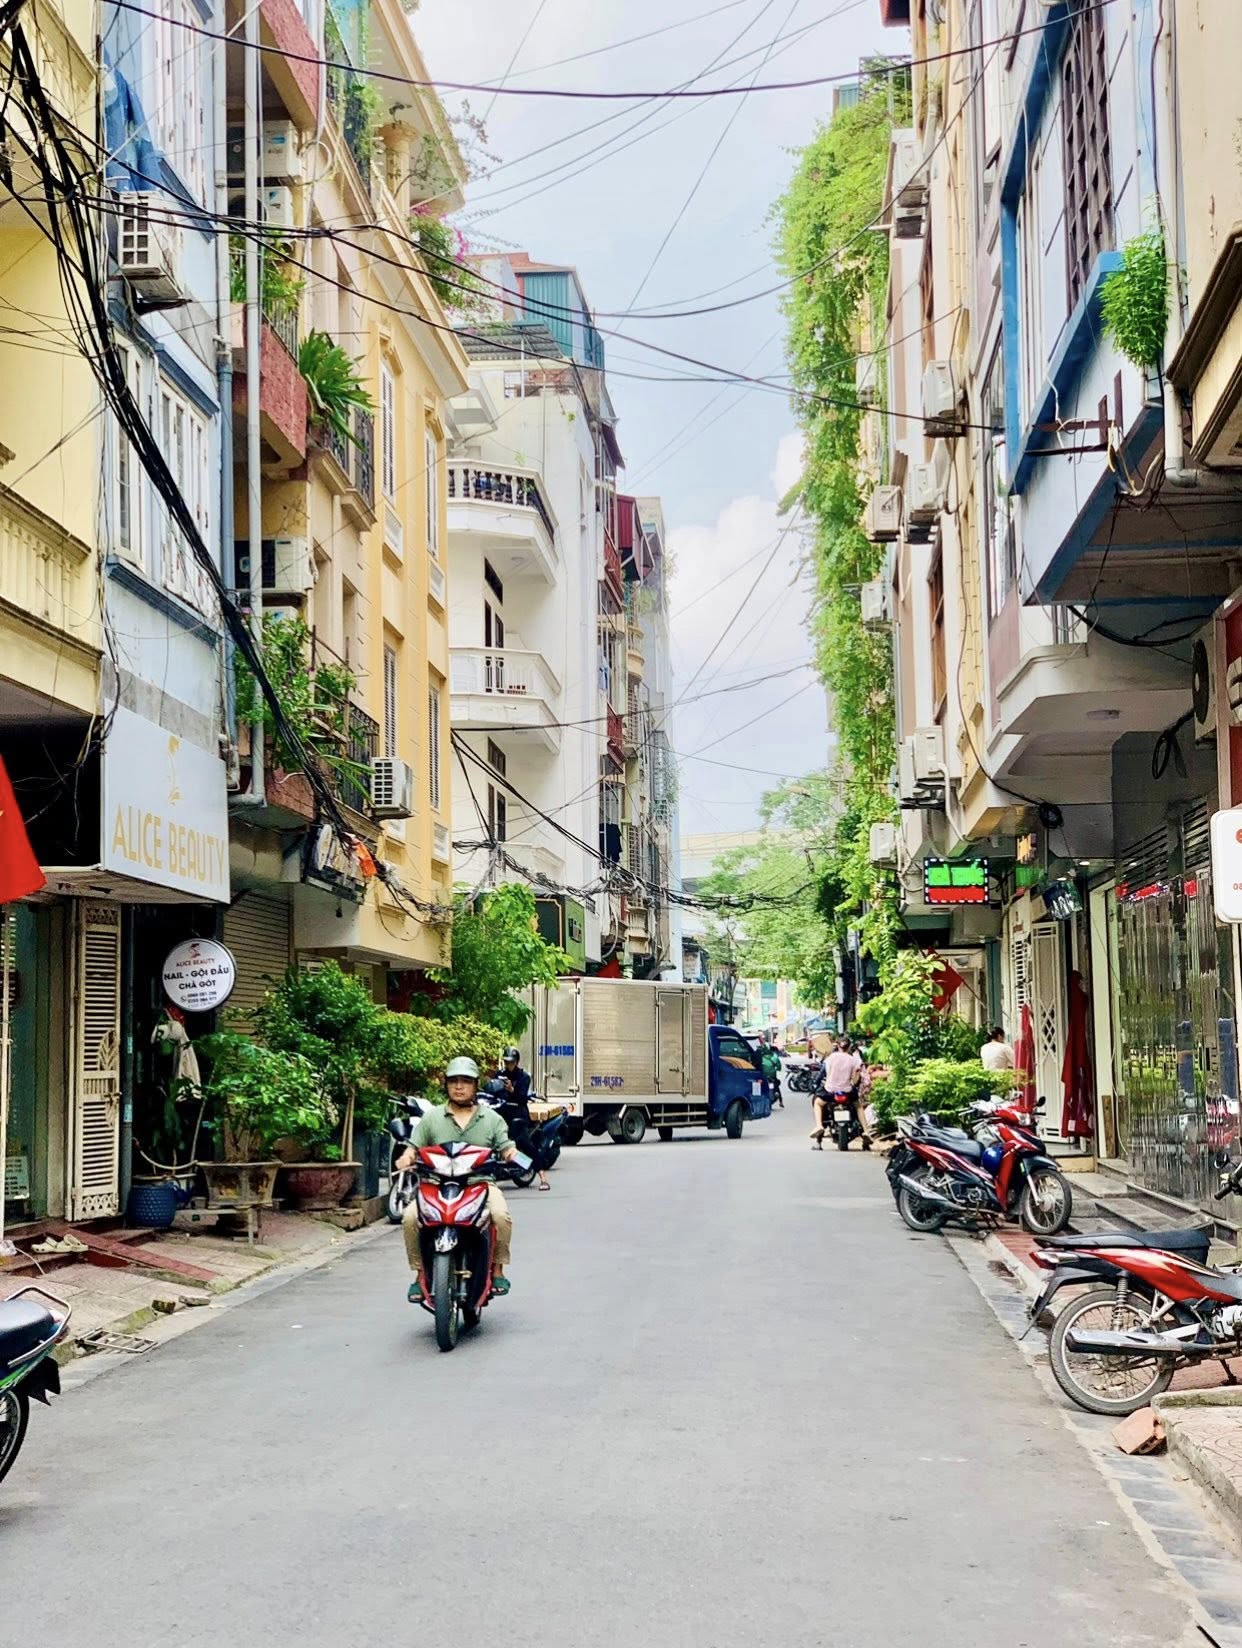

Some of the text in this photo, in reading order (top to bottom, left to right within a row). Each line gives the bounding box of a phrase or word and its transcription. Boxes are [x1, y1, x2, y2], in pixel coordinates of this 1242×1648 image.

[112, 803, 225, 886] ALICE BEAUTY
[193, 958, 215, 966] BEAUTY
[164, 972, 184, 980] NAIL
[190, 968, 208, 978] GỘI
